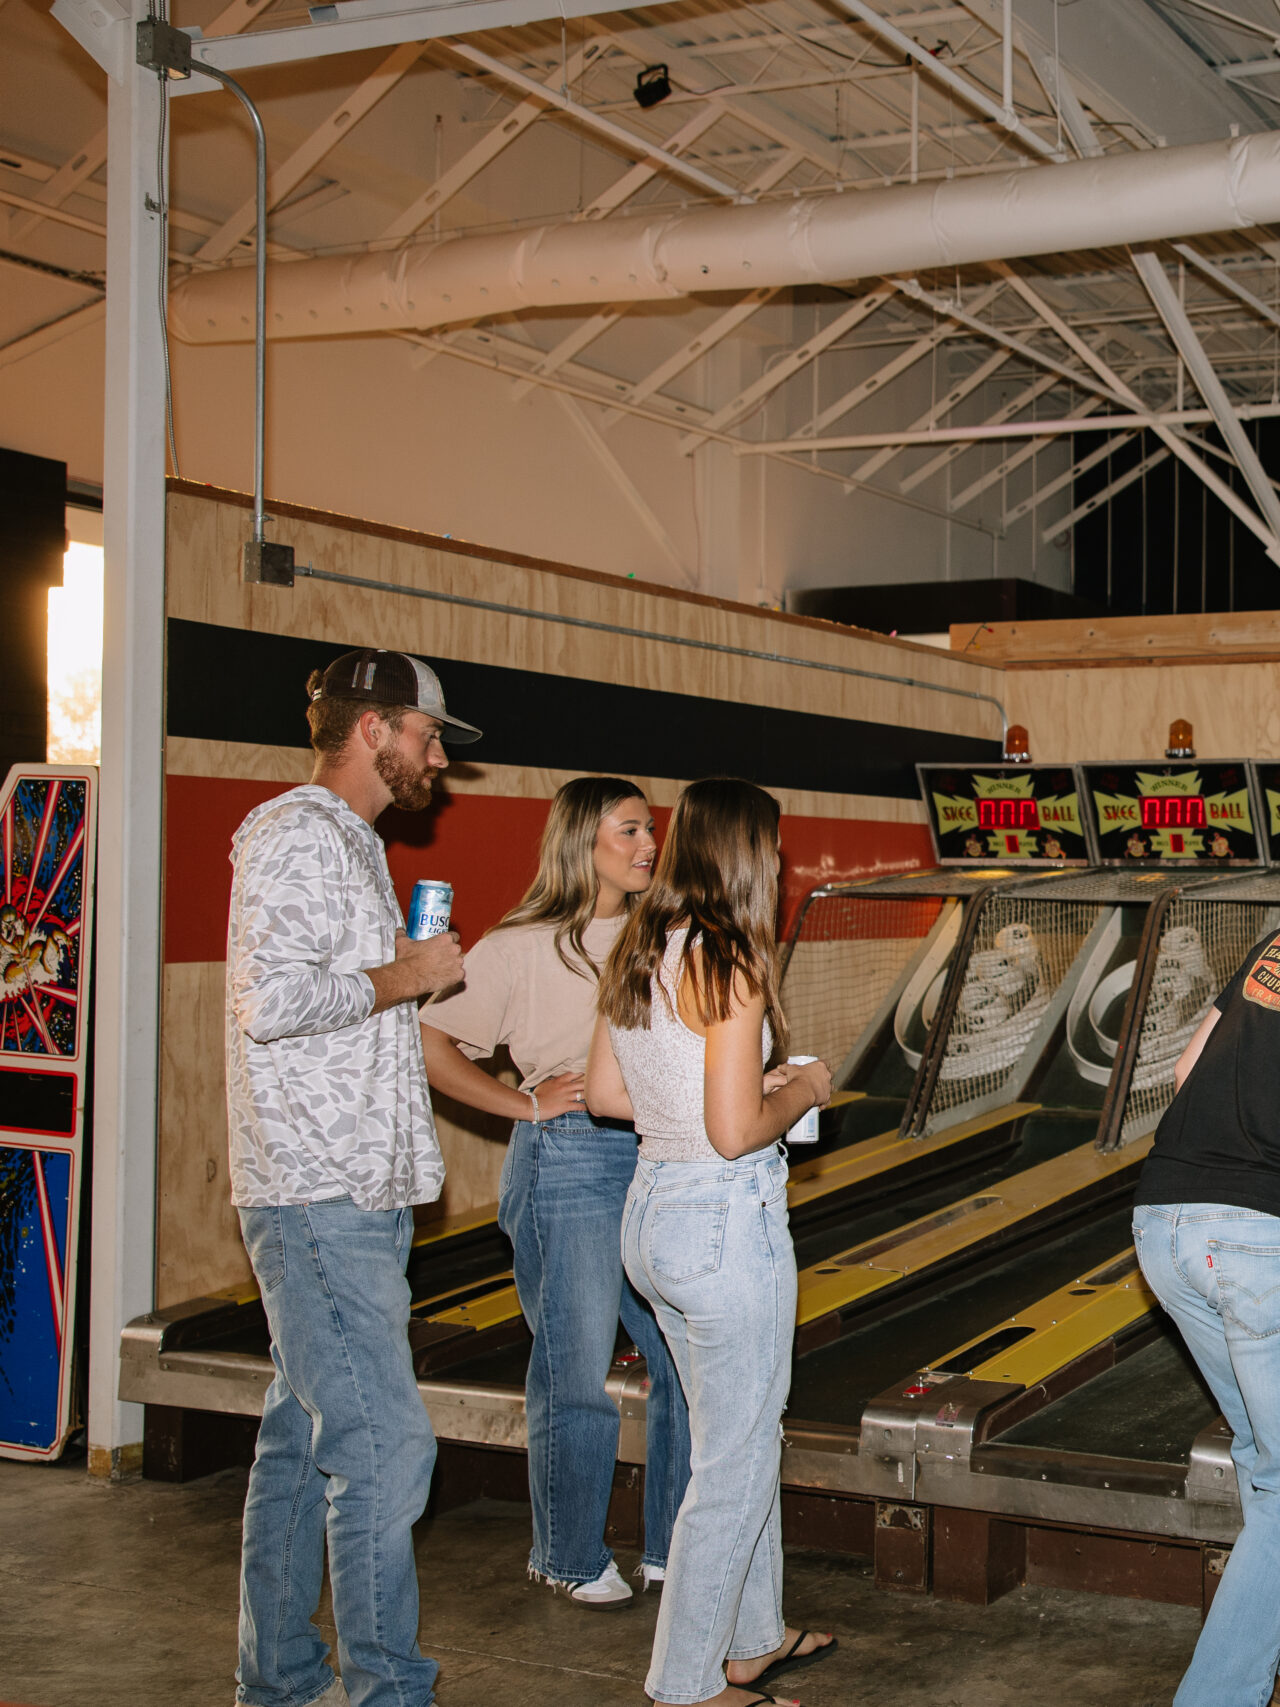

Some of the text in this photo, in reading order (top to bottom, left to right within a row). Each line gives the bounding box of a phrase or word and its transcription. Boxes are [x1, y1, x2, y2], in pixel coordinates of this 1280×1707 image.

[1151, 780, 1188, 792] WINNER
[942, 805, 1075, 822] SKEE BALL
[1103, 803, 1244, 821] SKEE BALL
